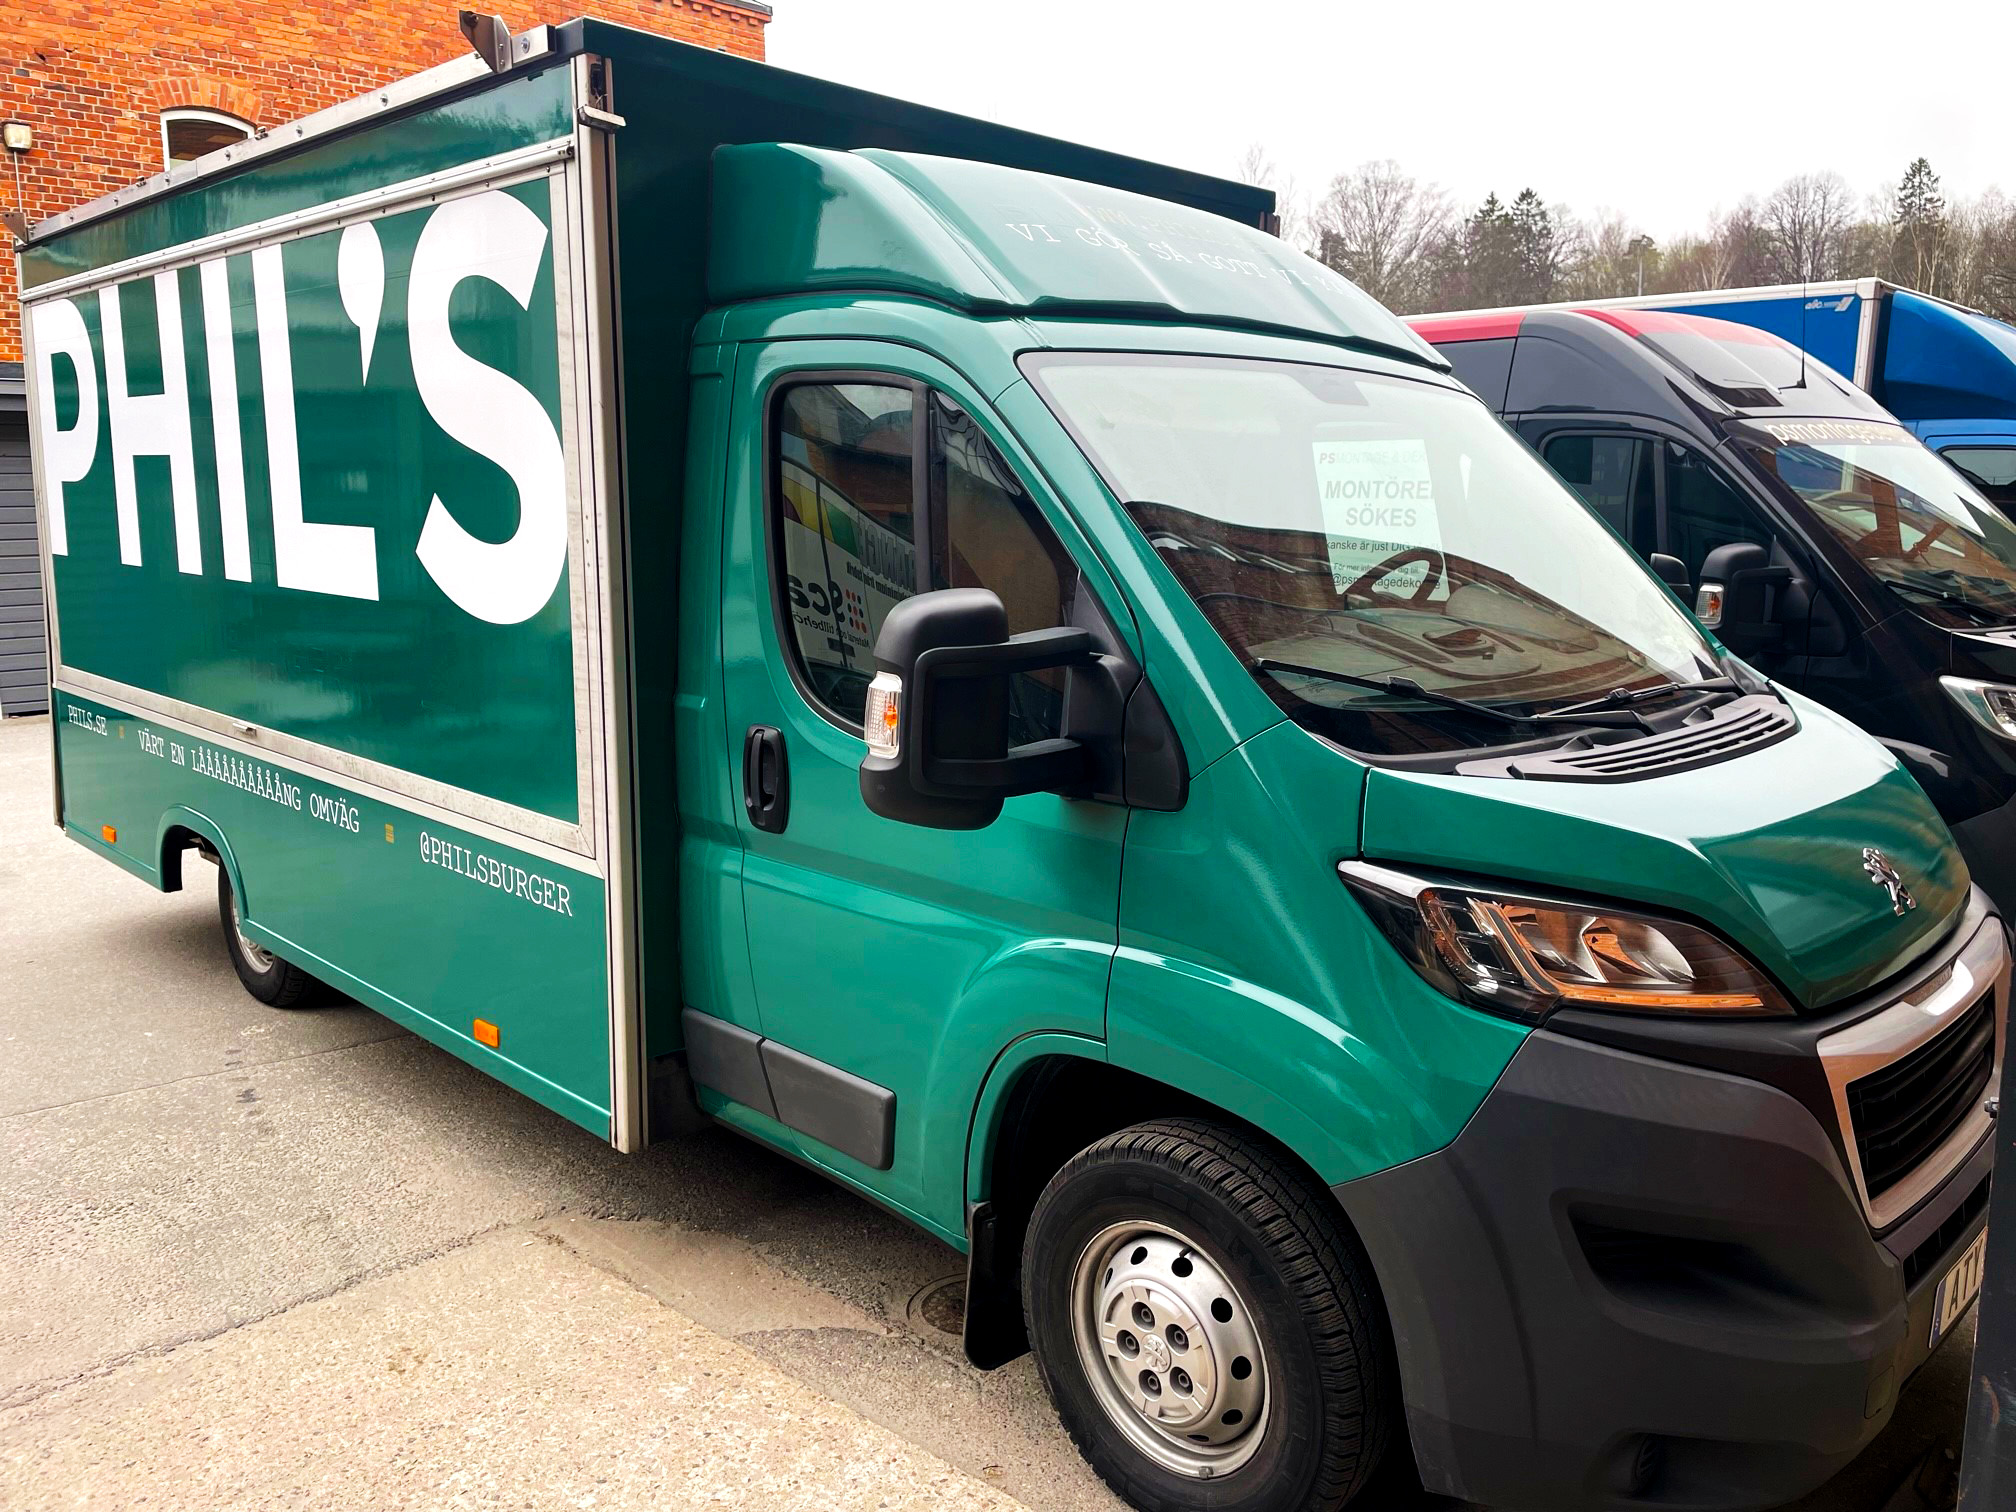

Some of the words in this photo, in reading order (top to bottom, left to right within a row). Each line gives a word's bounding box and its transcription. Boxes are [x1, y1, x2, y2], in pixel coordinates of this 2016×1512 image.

[1006, 223, 1062, 243] VI
[1075, 226, 1141, 257] GÖR
[1148, 239, 1193, 264] SÅ
[1200, 252, 1269, 280] GOTT
[31, 189, 568, 625] PHIL'S
[1325, 475, 1434, 500] MONTÖRE
[1345, 503, 1417, 528] SÖKES
[1359, 541, 1369, 550] är
[1370, 541, 1389, 552] just
[67, 704, 108, 737] PHILS.SE
[138, 728, 164, 758] VÄRT
[170, 741, 185, 766] EN
[309, 792, 360, 834] OMVÄG
[420, 831, 573, 917] @PHILSBURGER
